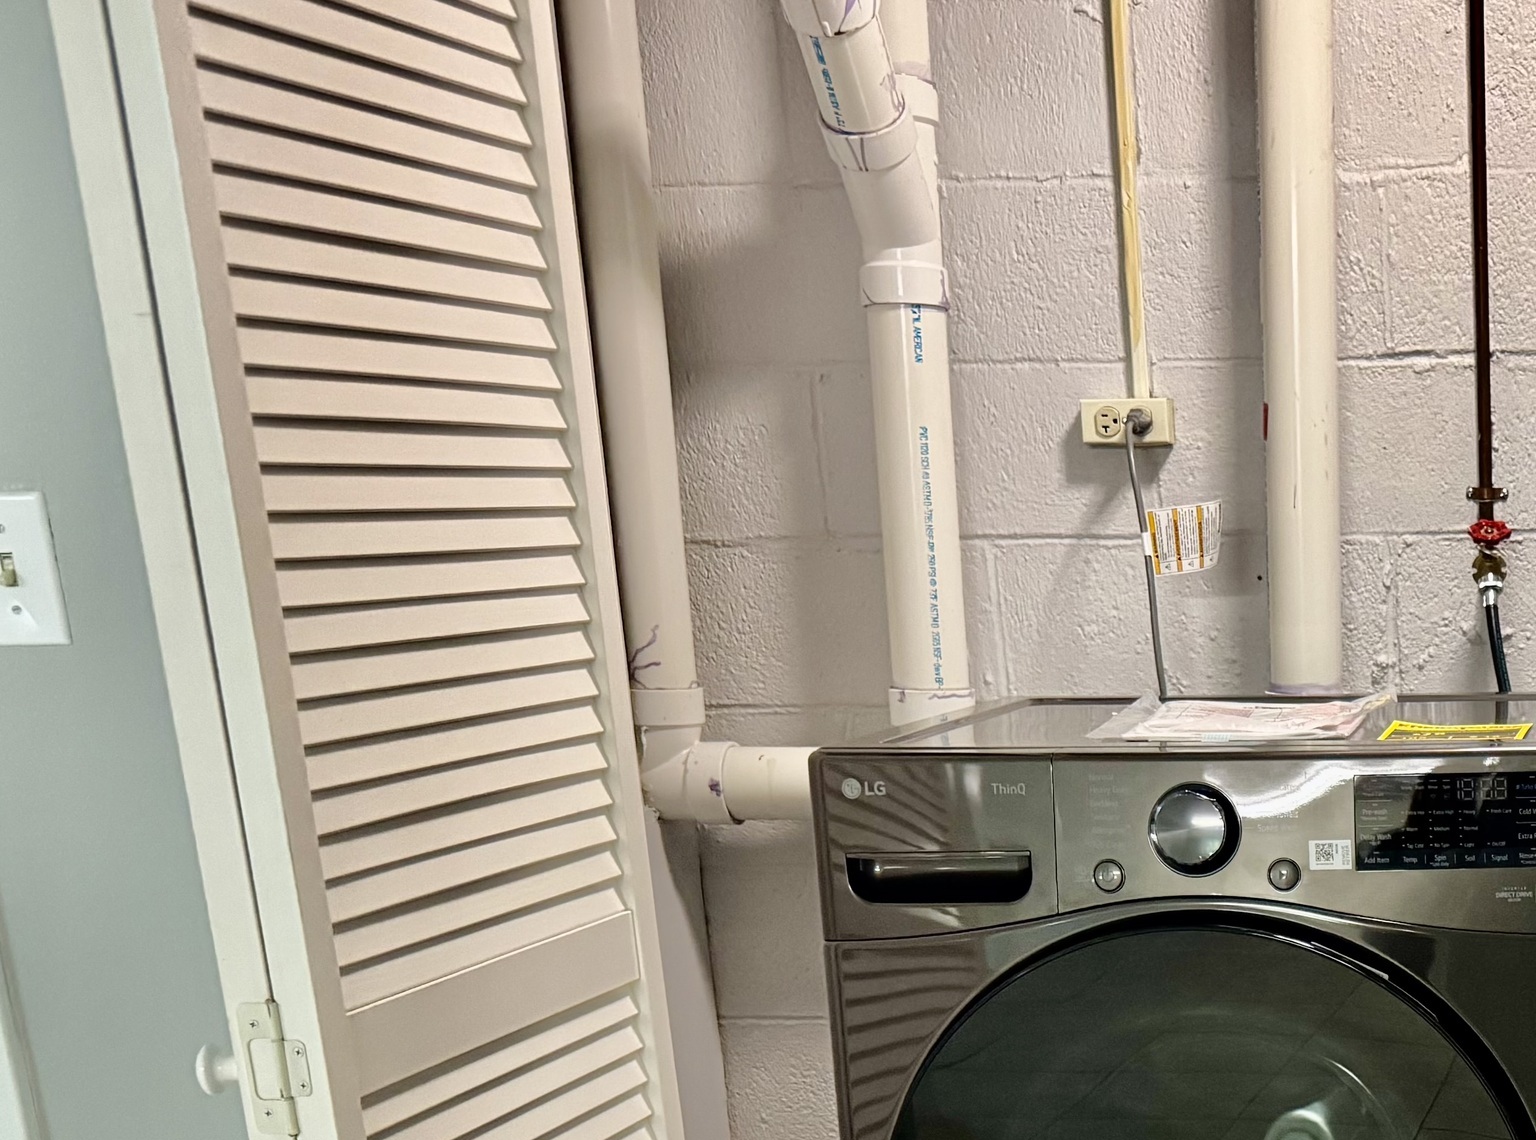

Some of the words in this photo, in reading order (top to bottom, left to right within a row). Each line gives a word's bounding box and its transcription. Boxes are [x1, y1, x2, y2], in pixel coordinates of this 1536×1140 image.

[913, 326, 924, 364] AMERICAN
[919, 426, 929, 441] PVC
[921, 456, 930, 470] SCH
[922, 481, 932, 501] ASTM
[930, 603, 940, 622] ASTM
[864, 781, 887, 796] LG
[991, 783, 1026, 796] ThinQ
[1517, 832, 1533, 840] Extra
[1434, 854, 1447, 862] Spin
[1491, 854, 1509, 862] Signal
